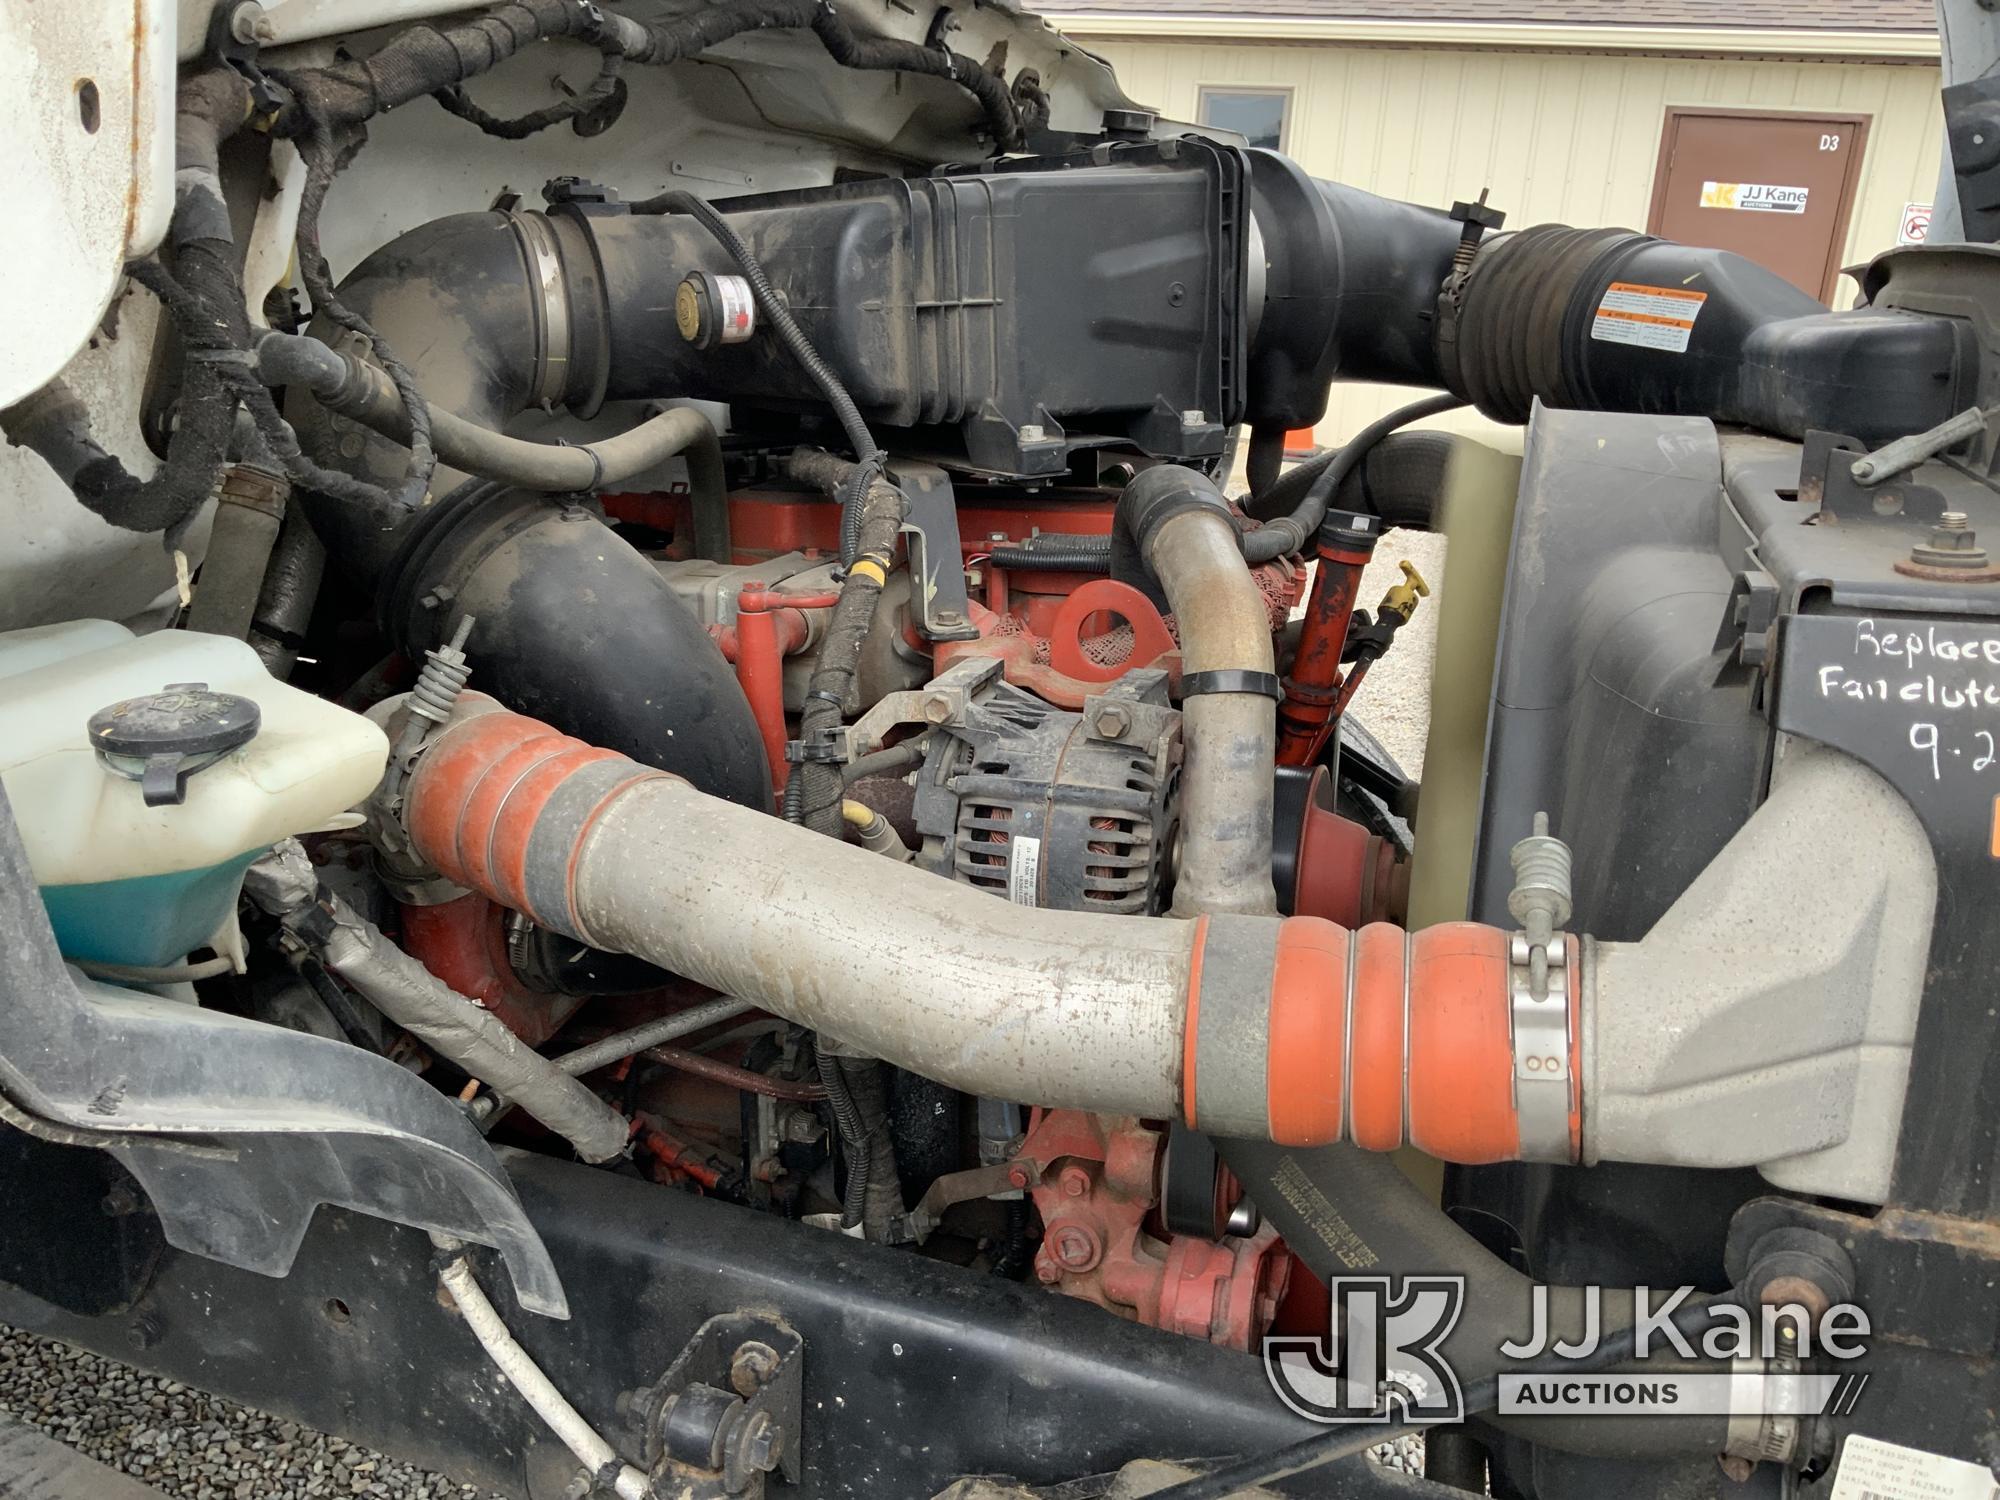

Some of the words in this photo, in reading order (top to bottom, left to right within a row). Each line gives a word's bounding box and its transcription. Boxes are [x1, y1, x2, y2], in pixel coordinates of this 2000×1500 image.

[1819, 134, 1840, 152] D3
[1742, 186, 1762, 200] JJ
[1765, 187, 1807, 203] Kane
[1742, 201, 1773, 209] AUCTIONS
[1855, 619, 2000, 669] Replace
[1818, 666, 1888, 700] Fan
